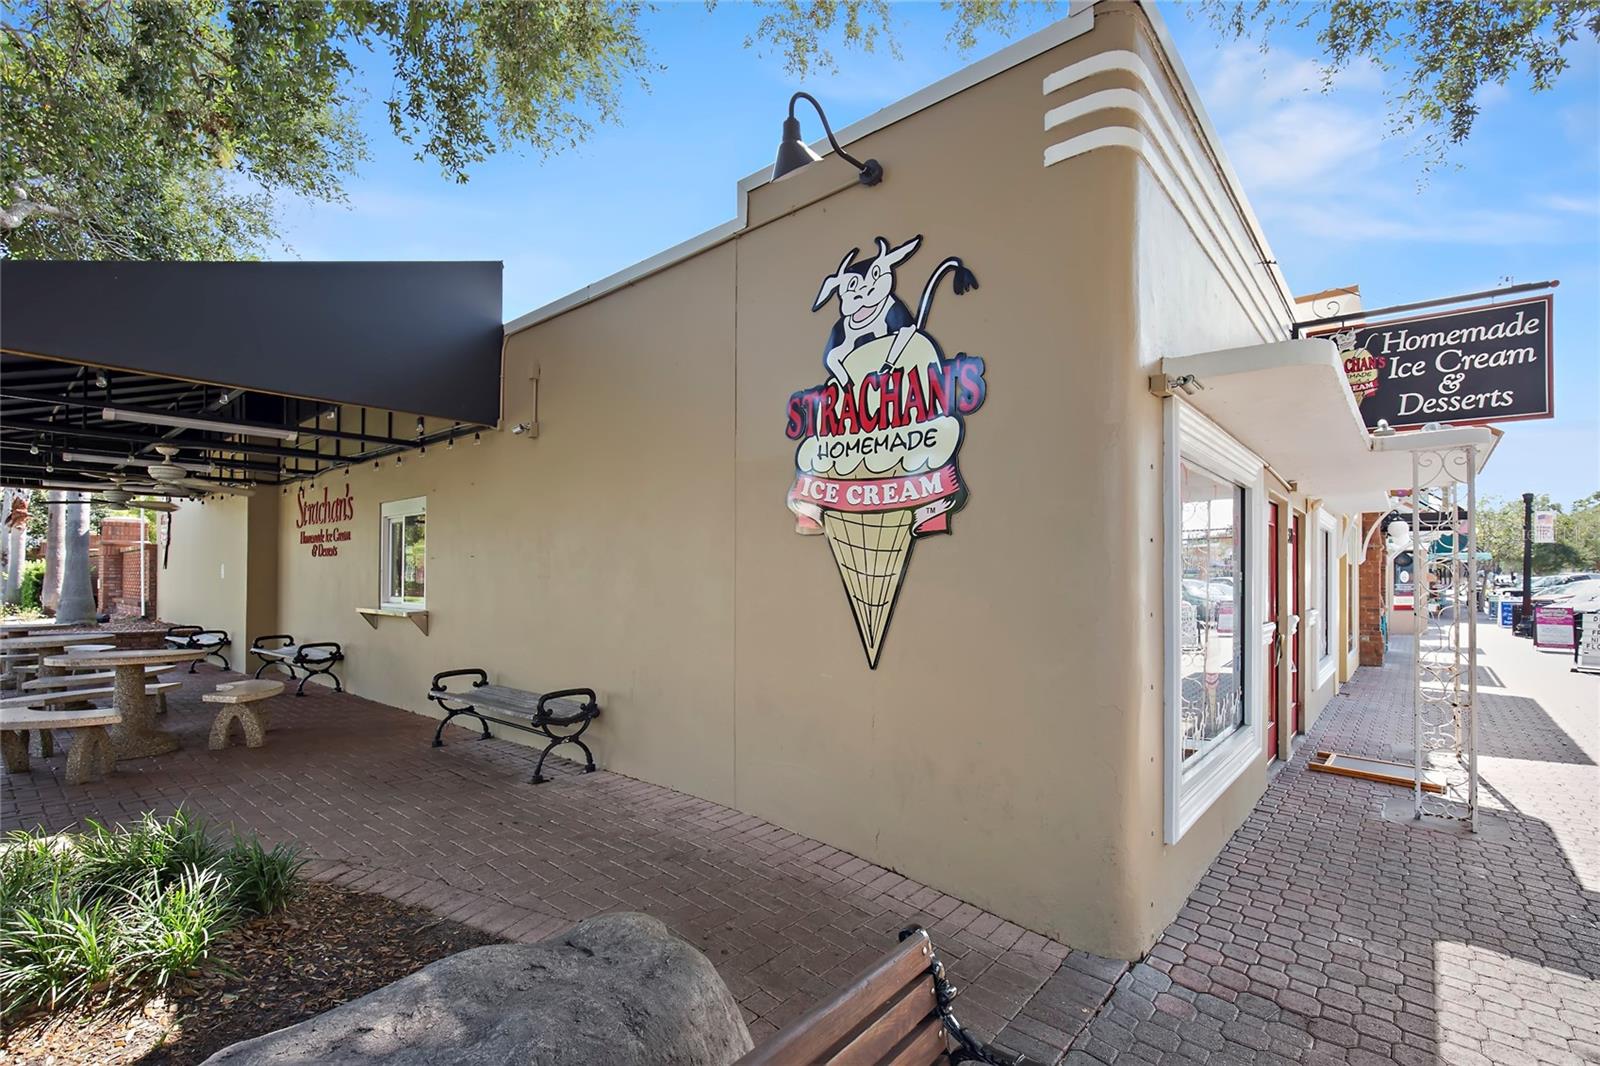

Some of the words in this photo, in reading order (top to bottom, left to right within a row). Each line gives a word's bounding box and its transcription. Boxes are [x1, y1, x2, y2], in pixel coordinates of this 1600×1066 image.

[1381, 311, 1540, 354] Homemade
[1343, 356, 1386, 373] CHAN'S
[1348, 371, 1372, 379] MADE
[1388, 356, 1426, 380] Ice
[1435, 347, 1537, 373] Cream
[1352, 381, 1374, 391] EAM
[1438, 372, 1466, 394] &
[786, 360, 982, 439] STRACHAN'S
[1397, 389, 1514, 416] Desserts
[817, 428, 938, 460] HOMEMADE
[801, 477, 840, 504] ICE
[846, 472, 944, 505] CREAM
[296, 483, 354, 528] Strachan's
